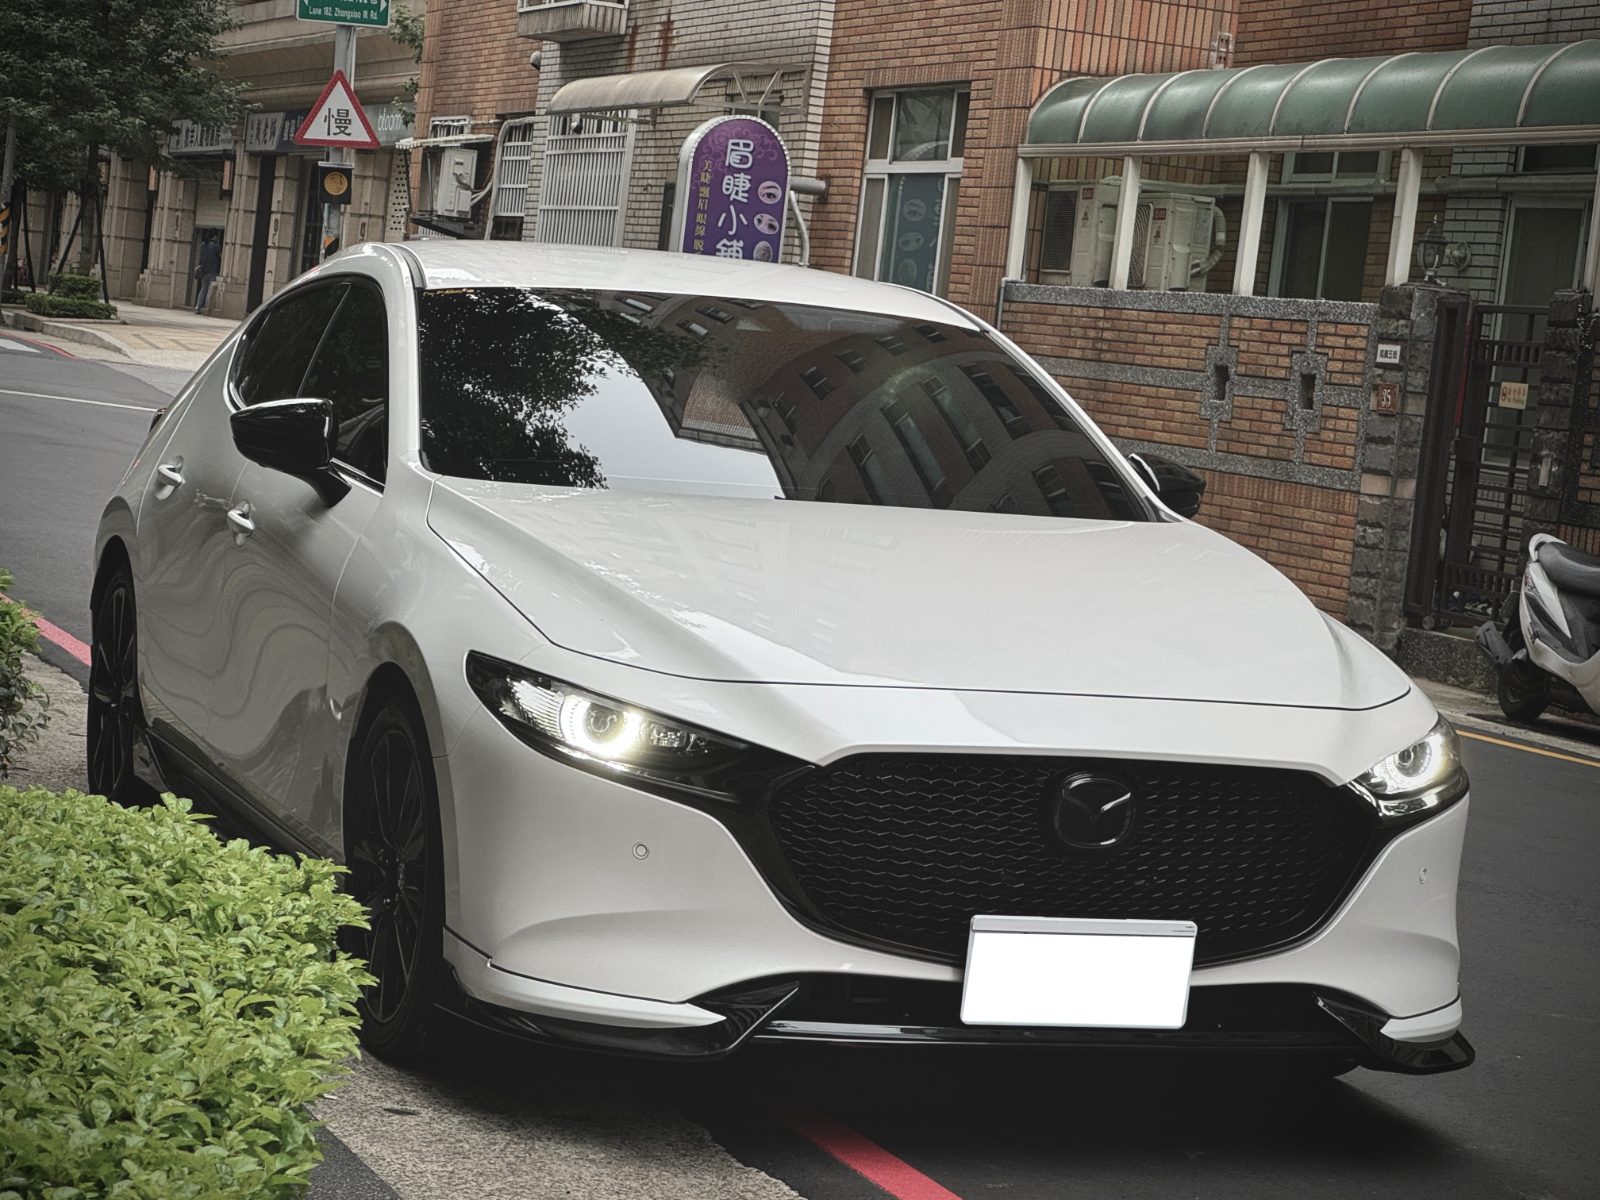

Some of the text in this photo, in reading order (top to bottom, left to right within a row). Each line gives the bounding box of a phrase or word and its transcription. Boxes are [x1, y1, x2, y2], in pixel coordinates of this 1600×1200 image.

[308, 6, 322, 16] Lane
[334, 7, 362, 20] Zhongxiao
[323, 107, 352, 137] 慢
